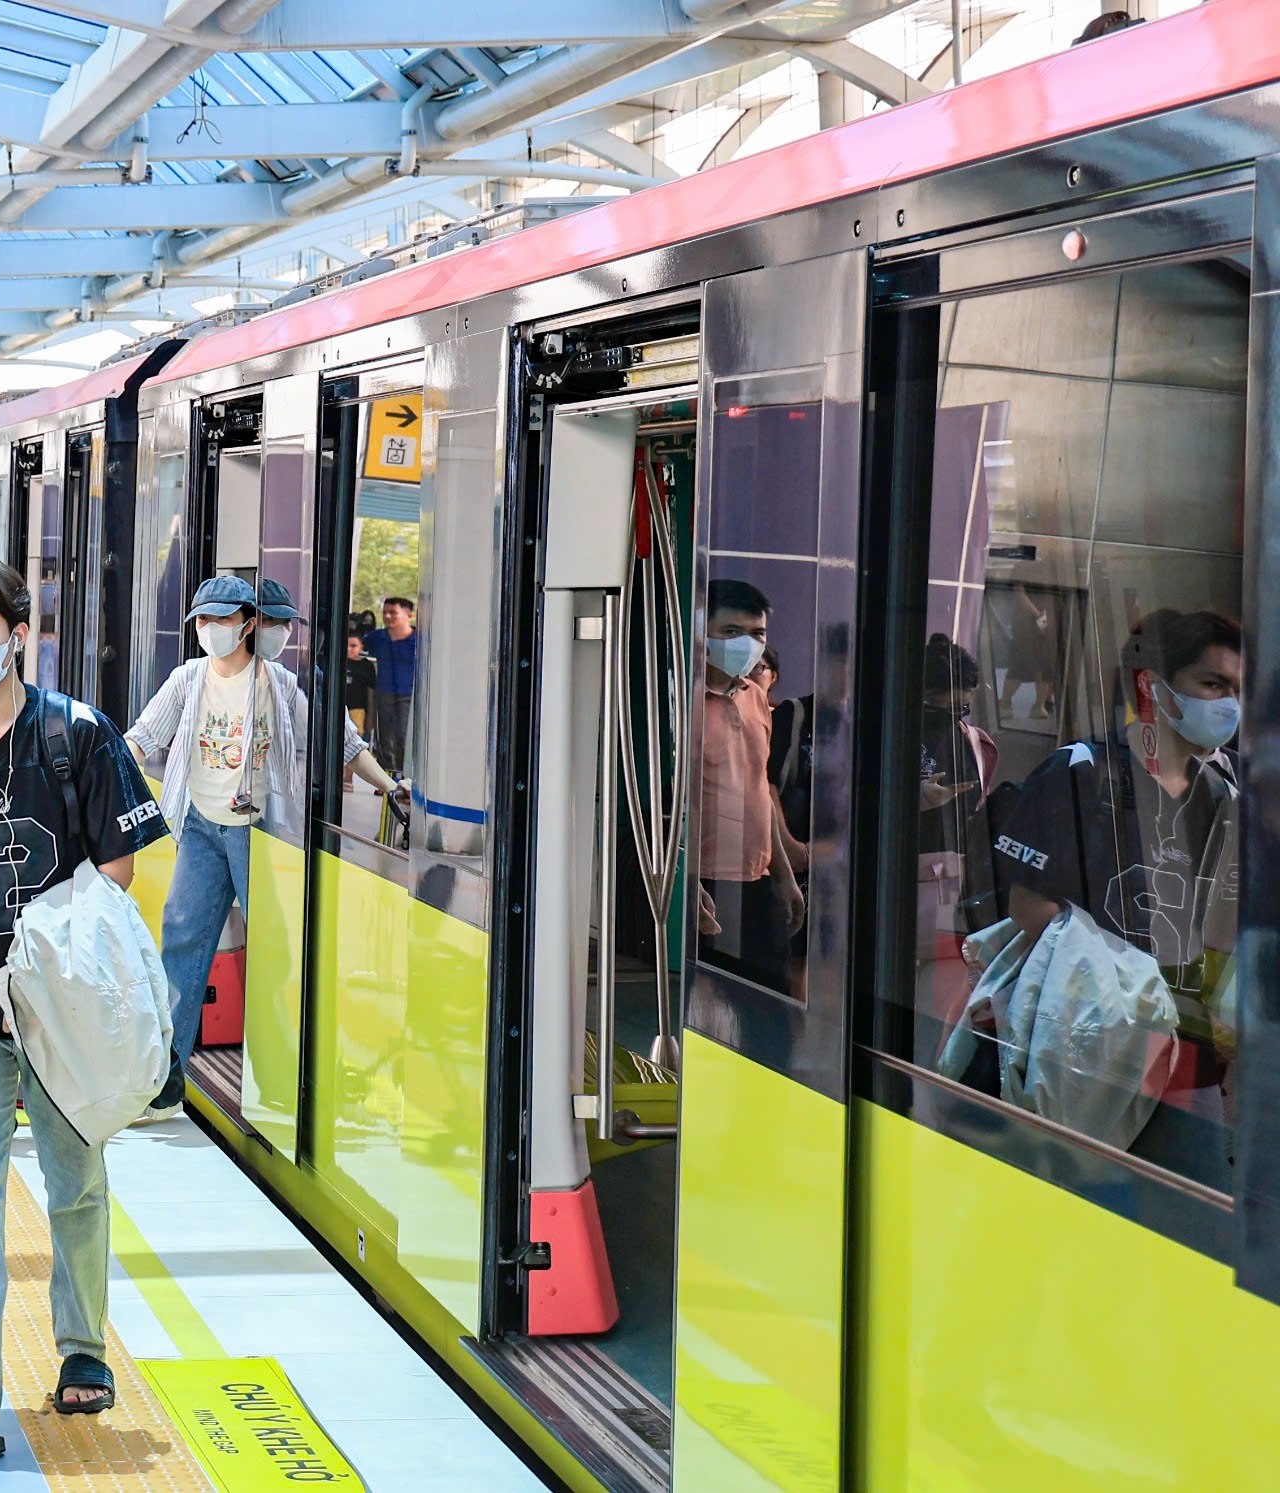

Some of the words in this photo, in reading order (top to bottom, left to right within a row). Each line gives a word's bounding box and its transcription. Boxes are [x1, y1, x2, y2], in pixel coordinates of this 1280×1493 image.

[117, 800, 160, 833] EVER
[220, 1383, 291, 1411] CHÚ
[192, 1409, 220, 1425] MIND
[243, 1414, 301, 1423] Ý
[204, 1427, 230, 1439] THE
[213, 1440, 239, 1454] GAP
[250, 1427, 316, 1456] KHE
